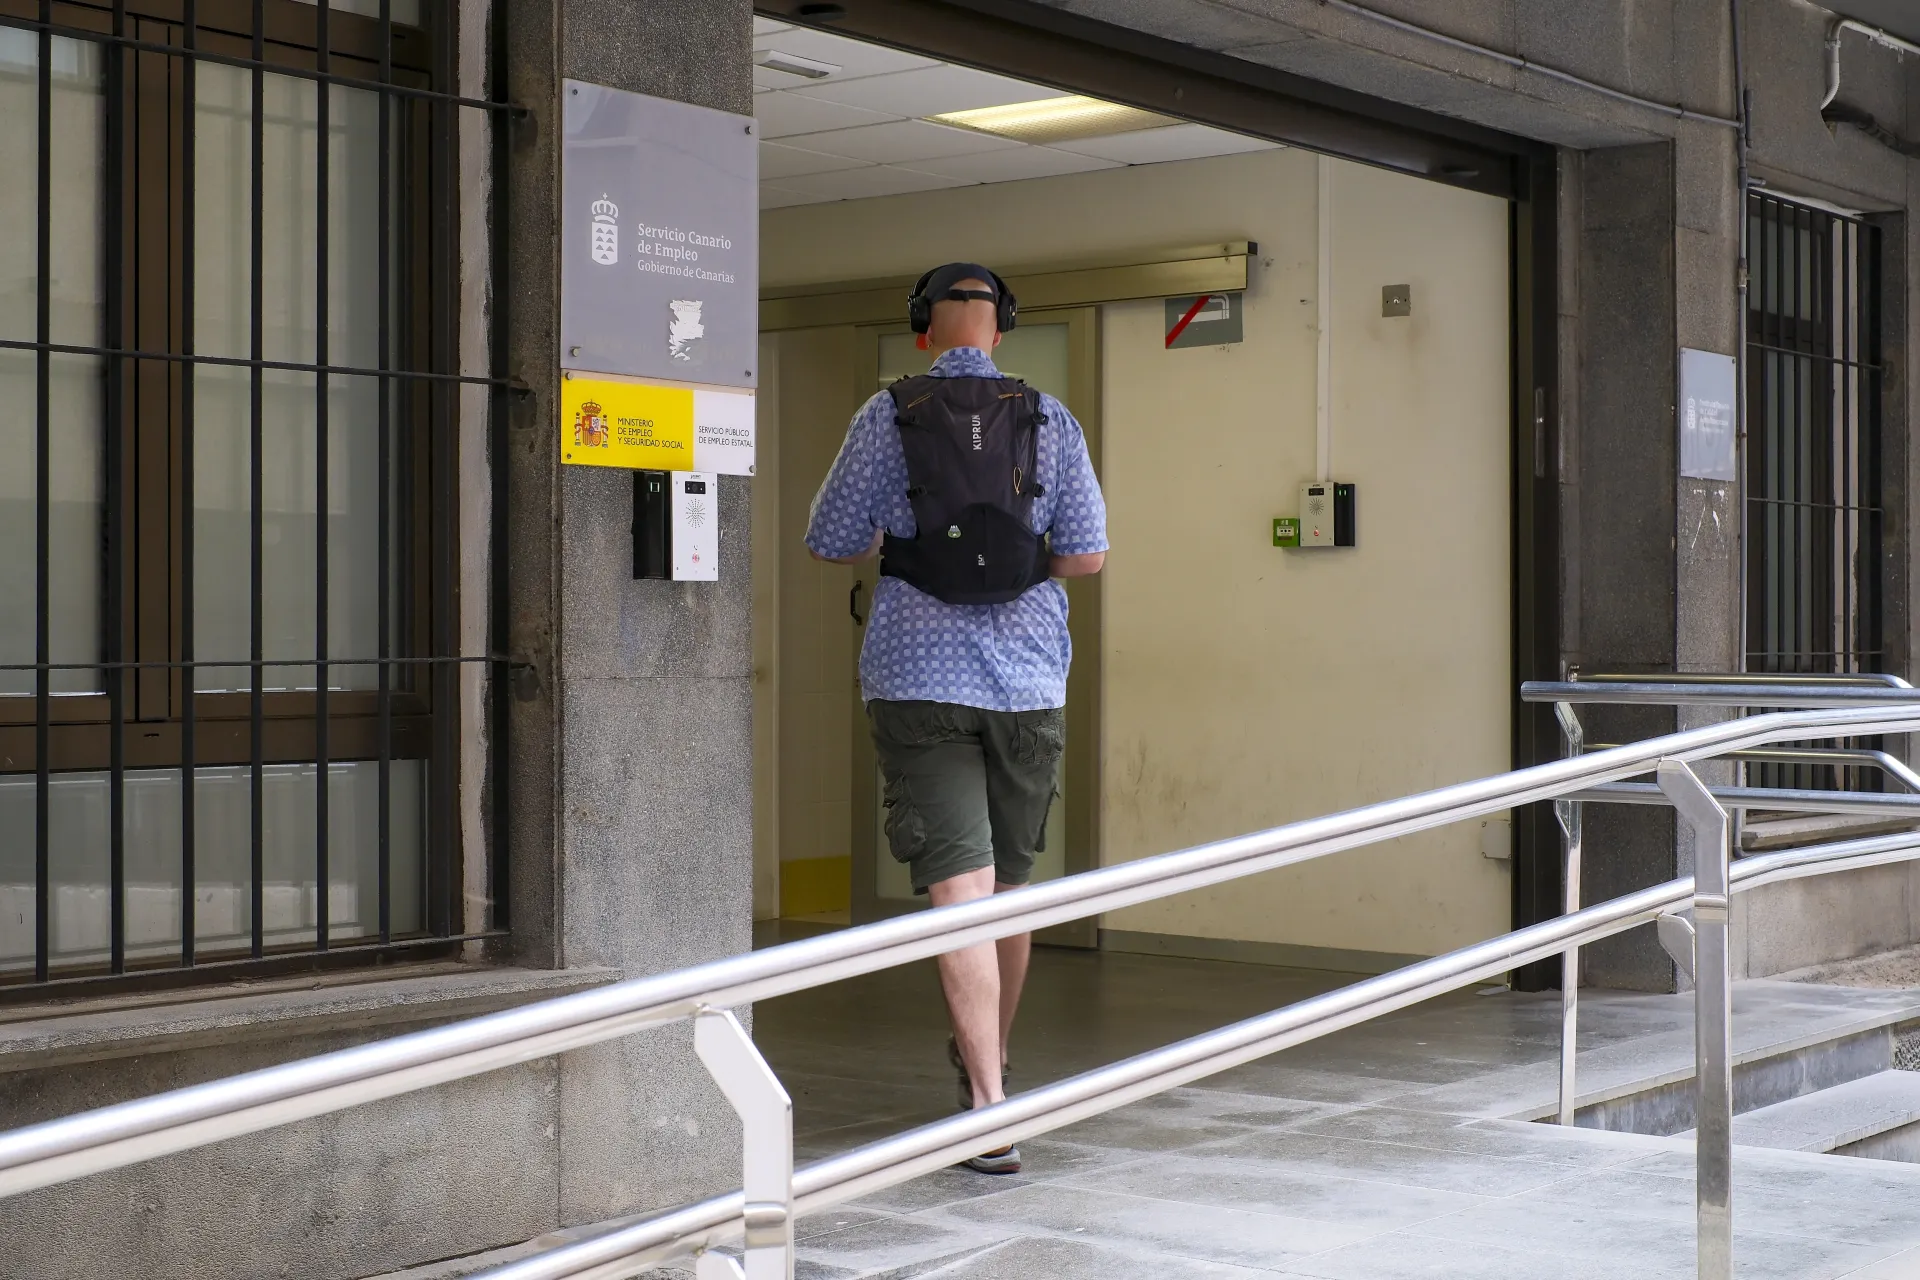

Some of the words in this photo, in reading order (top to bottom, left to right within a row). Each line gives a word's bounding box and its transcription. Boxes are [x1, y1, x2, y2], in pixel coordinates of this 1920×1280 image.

[638, 223, 686, 242] Servicio
[688, 231, 732, 250] Canario
[637, 240, 652, 254] de
[654, 242, 698, 262] Empleo
[637, 259, 682, 276] Gobierno
[683, 265, 694, 278] de
[695, 267, 735, 284] Canarias
[617, 417, 654, 428] MINISTERIO
[617, 427, 627, 435] DE
[628, 428, 653, 437] EMPLEO
[698, 425, 724, 435] SERVICIO
[725, 426, 750, 437] PÚBLICO
[971, 414, 982, 451] KIPRUN
[617, 437, 622, 445] Y
[623, 437, 661, 448] SEGURIDAD
[661, 440, 685, 449] SOCIAL
[698, 436, 707, 444] DE
[707, 437, 730, 446] EMPLEO
[731, 438, 754, 448] ESTATAL
